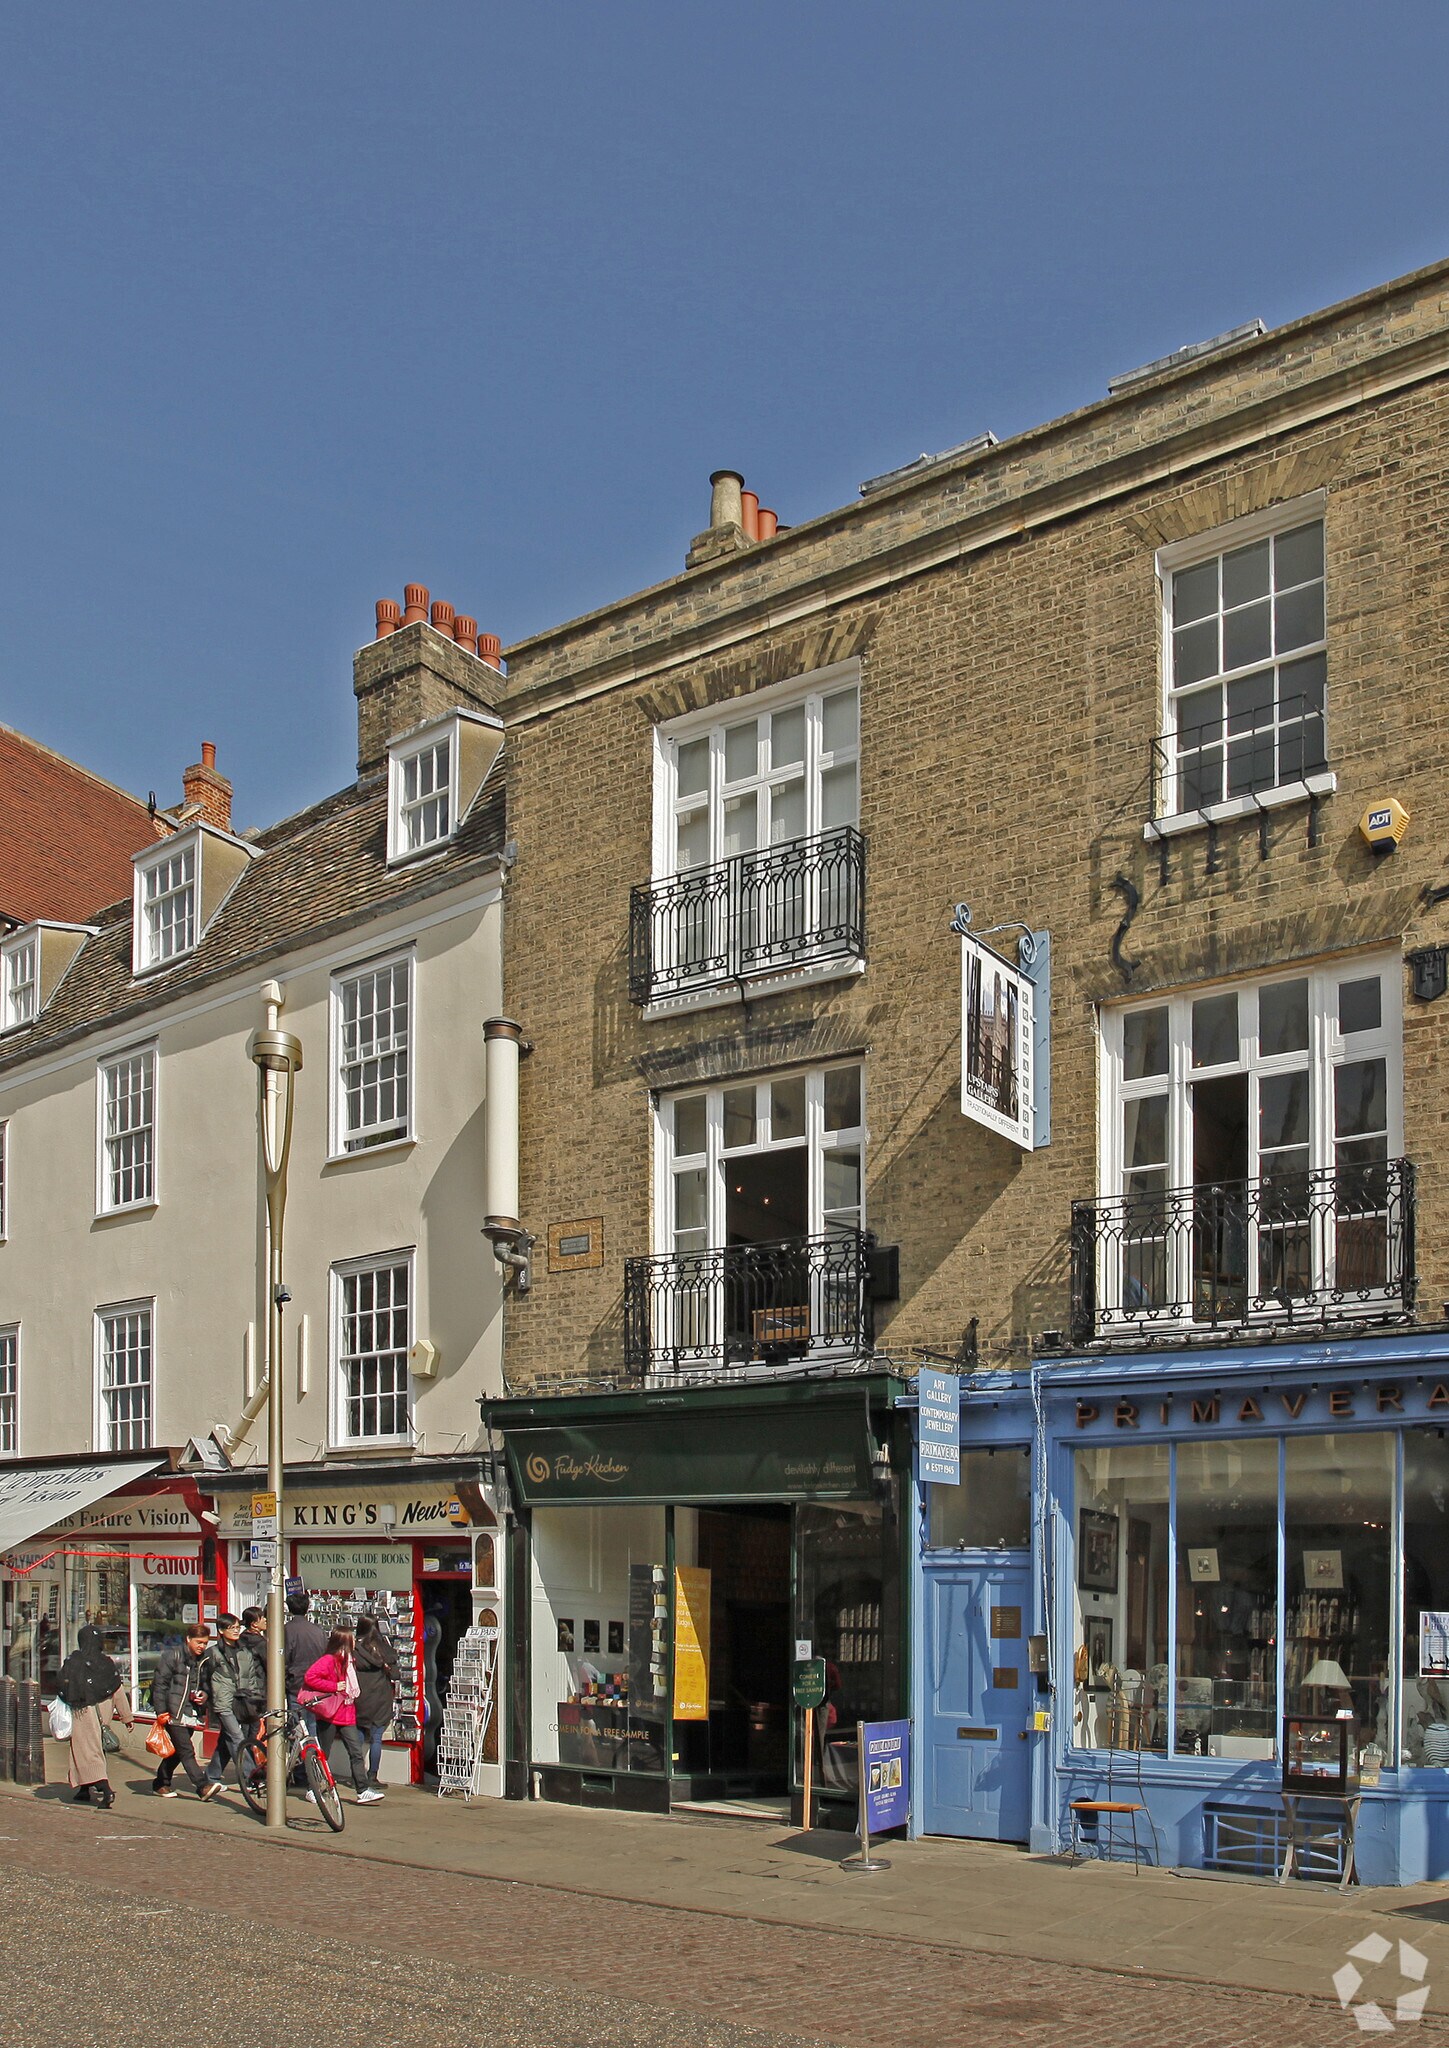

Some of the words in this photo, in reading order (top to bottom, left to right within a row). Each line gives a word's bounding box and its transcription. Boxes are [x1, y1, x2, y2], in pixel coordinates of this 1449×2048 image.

[1369, 811, 1391, 827] ADT
[1022, 991, 1030, 1141] PRIMAVERA
[967, 1073, 999, 1097] UPSTAIRS
[967, 1084, 998, 1107] GALLERY
[933, 1379, 946, 1391] ART
[926, 1390, 952, 1404] GALLERY
[1075, 1383, 1449, 1428] PRIMAVERA
[920, 1406, 959, 1422] CONTEMPORARY
[925, 1420, 954, 1433] JEWELLERY
[920, 1442, 959, 1460] PRIMAVERA
[554, 1455, 584, 1480] Fudge
[583, 1454, 630, 1482] Kitchen
[19, 1490, 82, 1503] Vision
[80, 1511, 132, 1527] Future
[137, 1508, 190, 1526] Vision
[293, 1501, 377, 1525] KING'S
[401, 1500, 449, 1525] News
[300, 1553, 346, 1565] SOUVENIRS
[351, 1553, 379, 1565] GUIDE
[381, 1553, 410, 1564] BOOKS
[330, 1568, 378, 1579] POSTCARDS
[548, 1723, 570, 1734] COME
[570, 1726, 579, 1734] IN
[603, 1728, 620, 1737] FREE
[621, 1730, 650, 1740] SAMPLE
